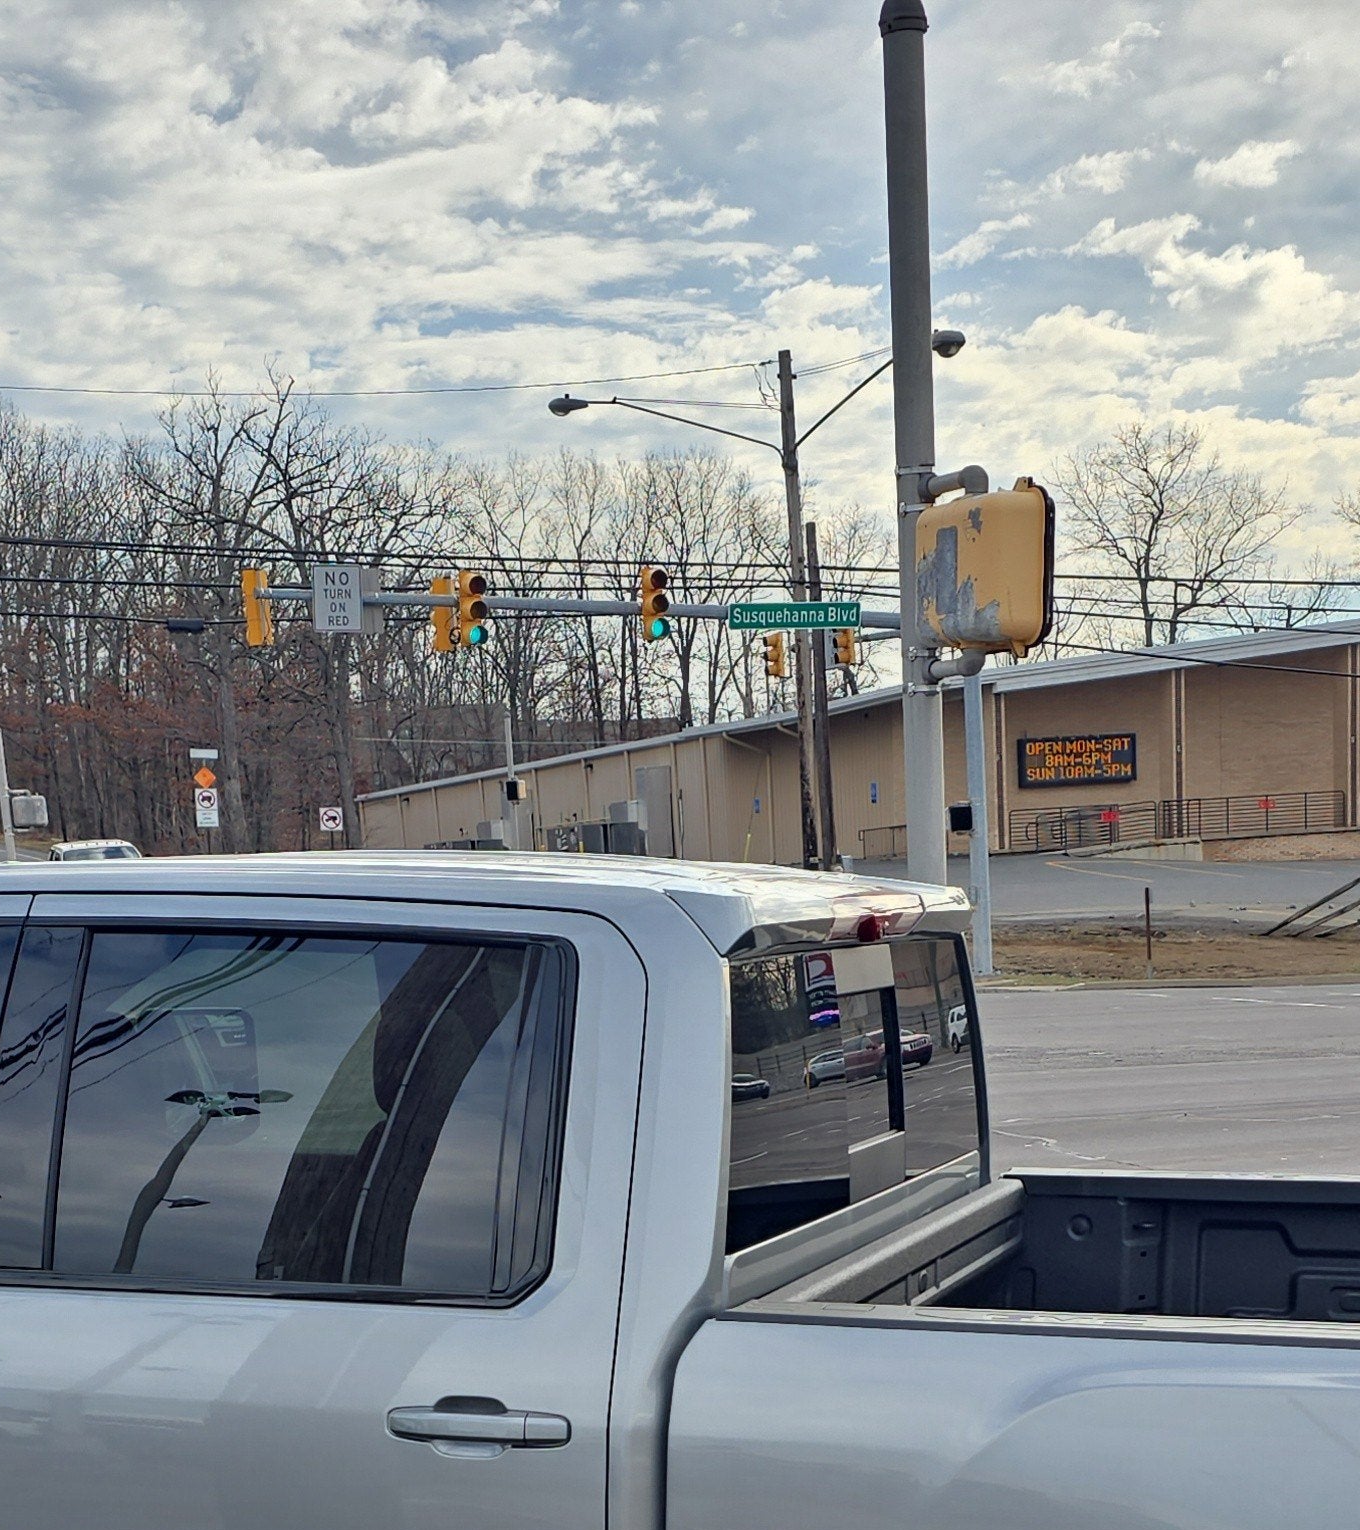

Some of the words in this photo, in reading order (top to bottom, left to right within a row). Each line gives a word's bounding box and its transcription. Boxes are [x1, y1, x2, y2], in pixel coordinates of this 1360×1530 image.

[325, 571, 349, 586] NO
[323, 588, 351, 599] TURN
[330, 602, 346, 613] ON
[328, 615, 349, 626] RED
[733, 608, 825, 626] Susquehanna
[828, 606, 857, 622] Blvd
[1026, 742, 1062, 755] OPEN
[1065, 738, 1130, 754] MON-SAT
[1045, 751, 1111, 767] 8AM-6PM
[1026, 767, 1055, 780] SUN
[1059, 763, 1132, 779] 10AM-5PM
